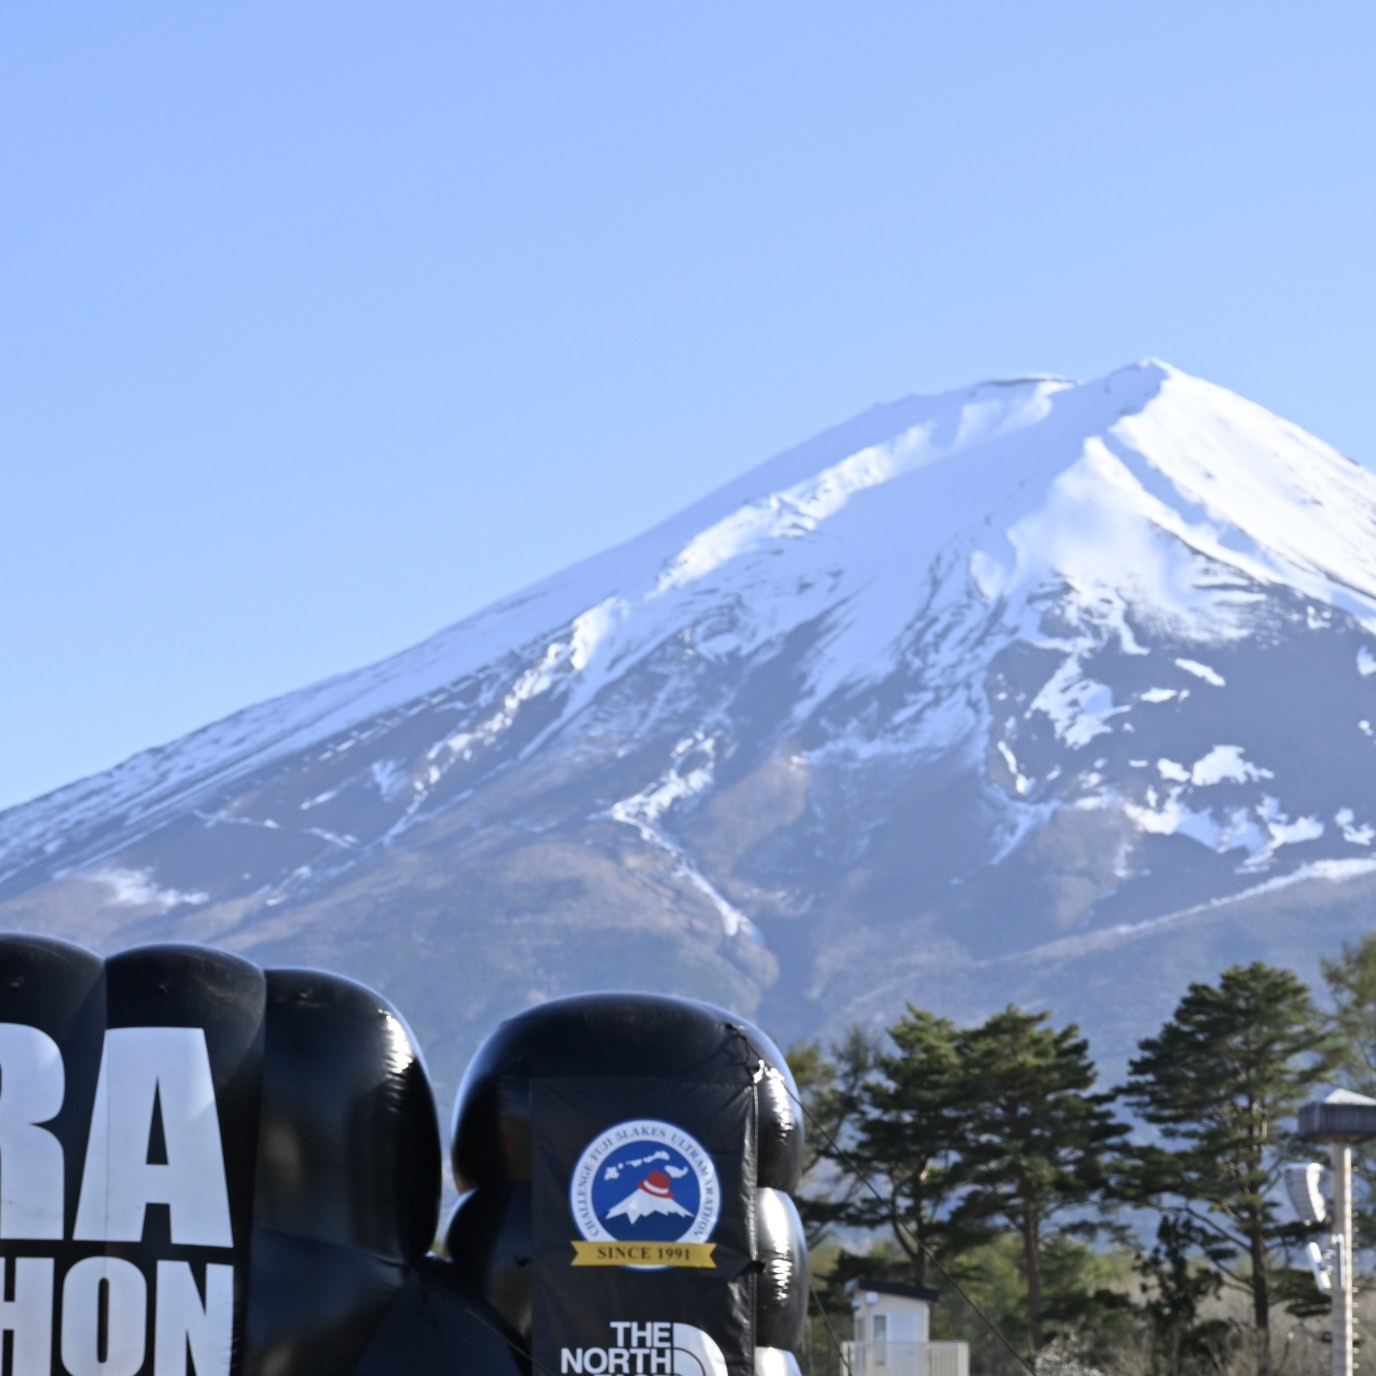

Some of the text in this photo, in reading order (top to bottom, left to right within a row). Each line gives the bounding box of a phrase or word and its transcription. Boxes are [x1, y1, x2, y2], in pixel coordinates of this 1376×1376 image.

[577, 1126, 715, 1239] CHALLENGE FUJI 5LAKES ULTRAMARATHON
[597, 1246, 691, 1261] SINCE 1991
[609, 1321, 671, 1348] THE
[560, 1347, 672, 1374] NORTH
